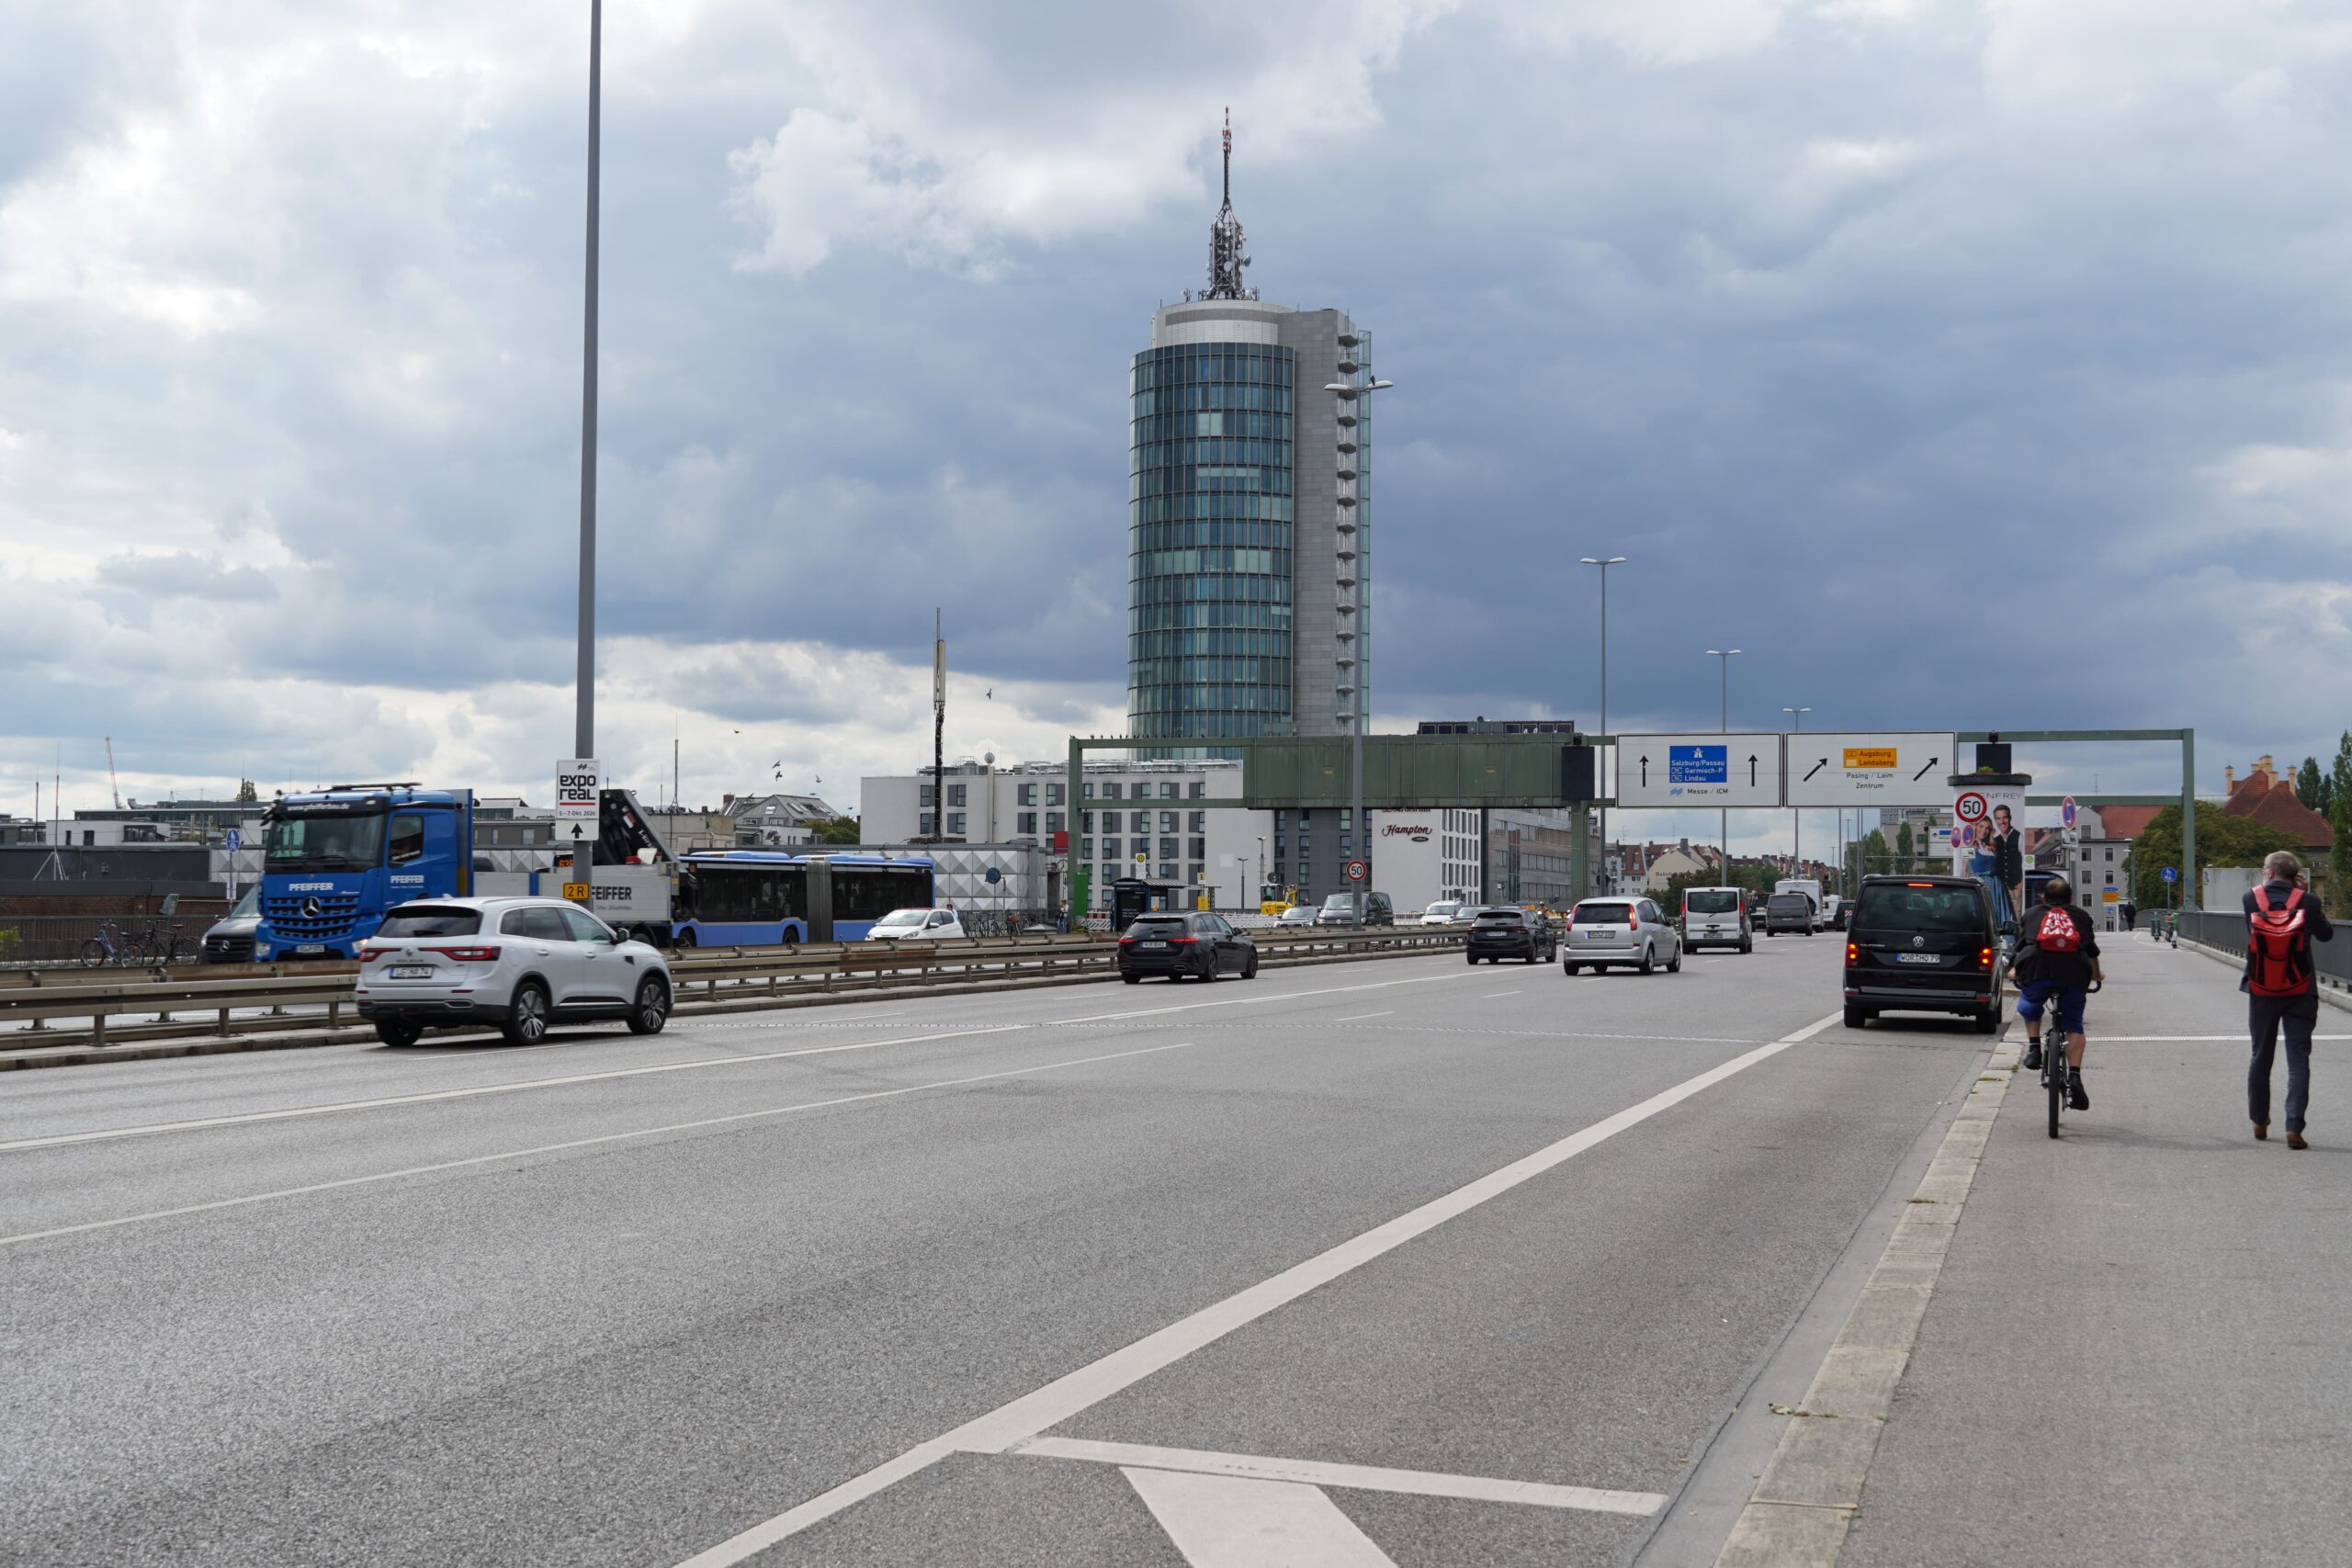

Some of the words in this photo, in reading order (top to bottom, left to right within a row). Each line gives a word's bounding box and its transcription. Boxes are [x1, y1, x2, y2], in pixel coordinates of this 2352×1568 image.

[560, 775, 596, 790] expo
[1962, 801, 1981, 815] 50
[1382, 825, 1432, 836] Hampton
[1351, 866, 1363, 875] 50
[390, 875, 424, 884] PFEIFFER
[288, 882, 334, 891] PFEIFFER
[568, 886, 574, 897] 2
[577, 886, 584, 897] R
[591, 886, 632, 900] FEIFFER
[1900, 953, 1914, 962] WOR
[1929, 954, 1939, 963] 79
